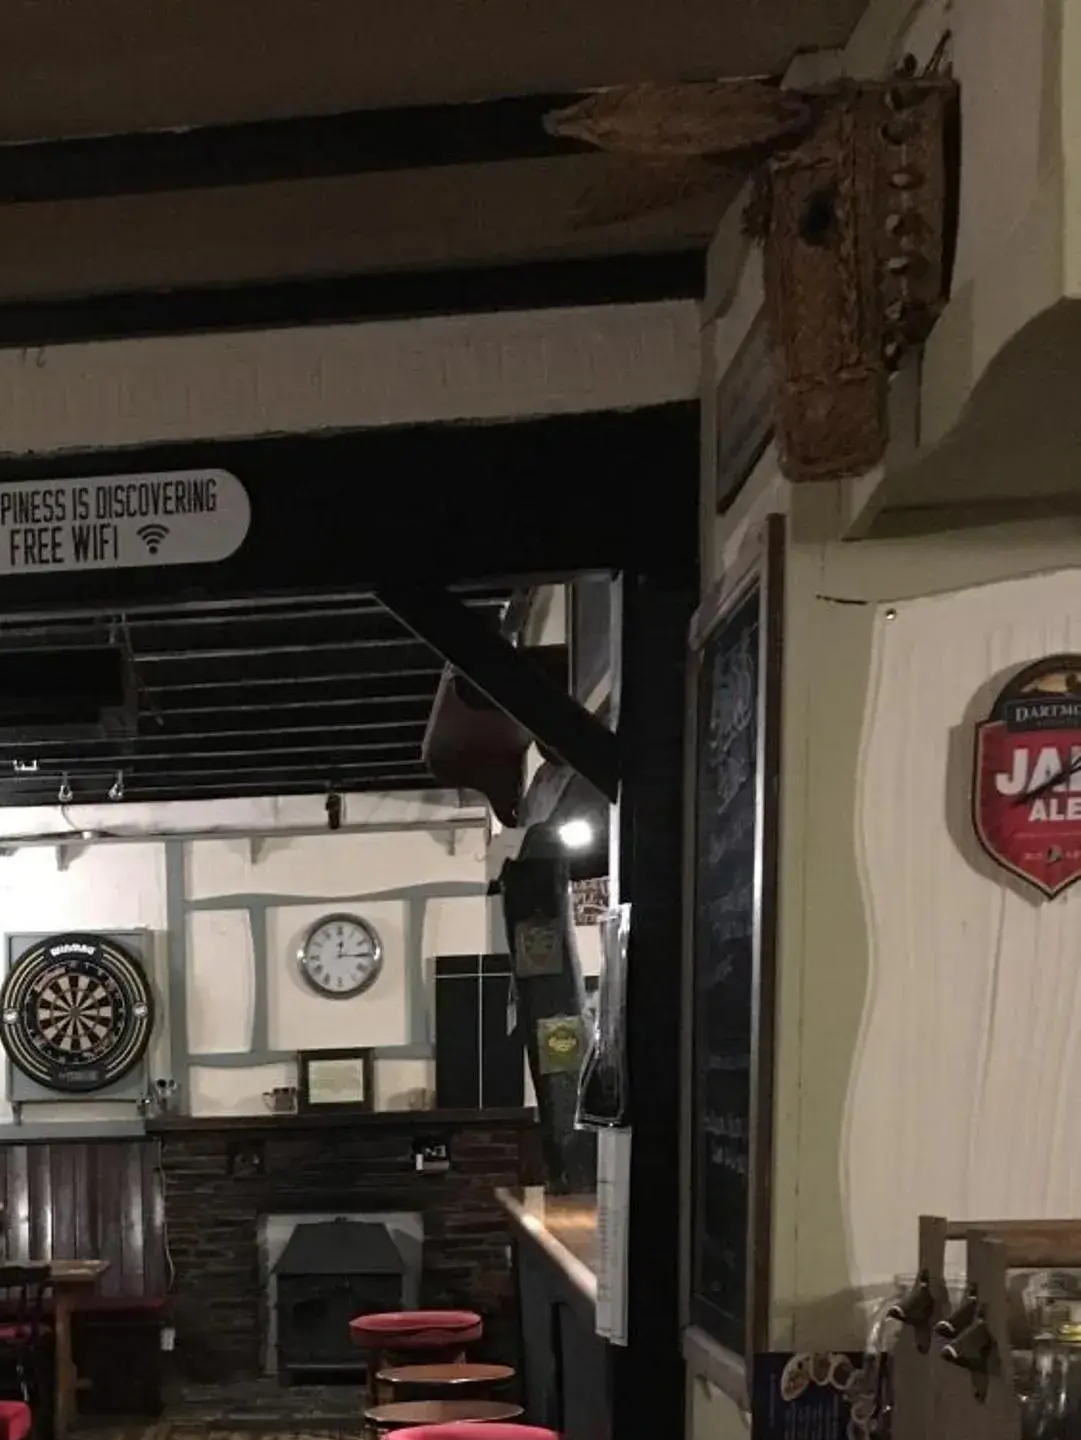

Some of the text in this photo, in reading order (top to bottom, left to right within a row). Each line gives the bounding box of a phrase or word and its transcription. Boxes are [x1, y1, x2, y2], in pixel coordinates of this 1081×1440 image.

[71, 486, 89, 521] IS
[95, 478, 217, 519] DISCOVERING
[10, 522, 119, 567] FREE WIFI
[1027, 797, 1081, 822] ALE
